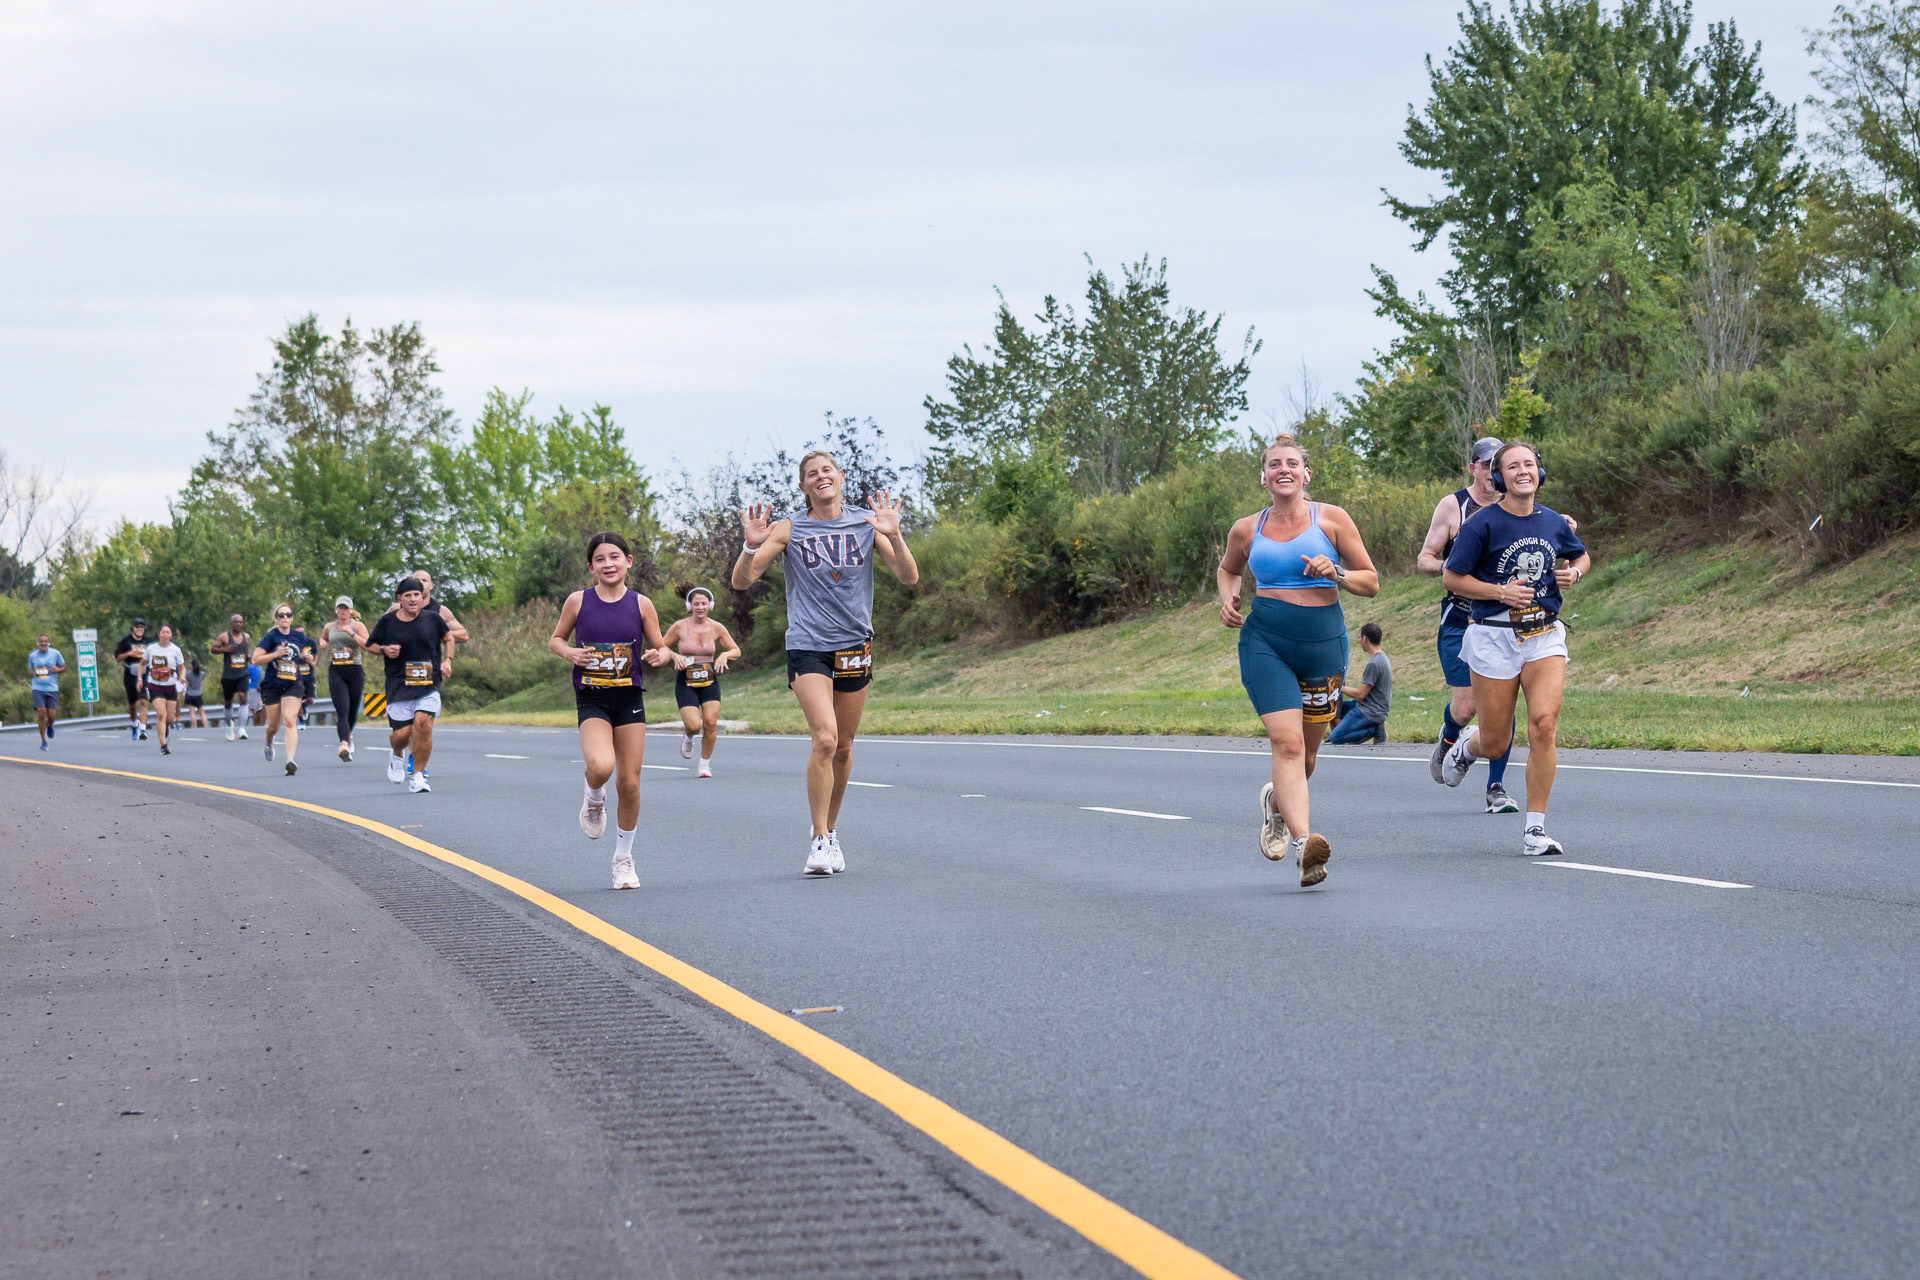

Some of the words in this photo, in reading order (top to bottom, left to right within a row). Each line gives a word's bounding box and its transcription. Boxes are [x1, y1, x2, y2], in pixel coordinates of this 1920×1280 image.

[796, 533, 865, 571] UVA
[1497, 537, 1538, 573] HILLSBOROUGH
[80, 657, 95, 665] 206
[585, 657, 628, 671] 247
[840, 655, 873, 670] 144
[81, 670, 96, 678] MILE
[411, 669, 428, 678] 33
[86, 678, 93, 688] 2
[1302, 688, 1340, 706] 234
